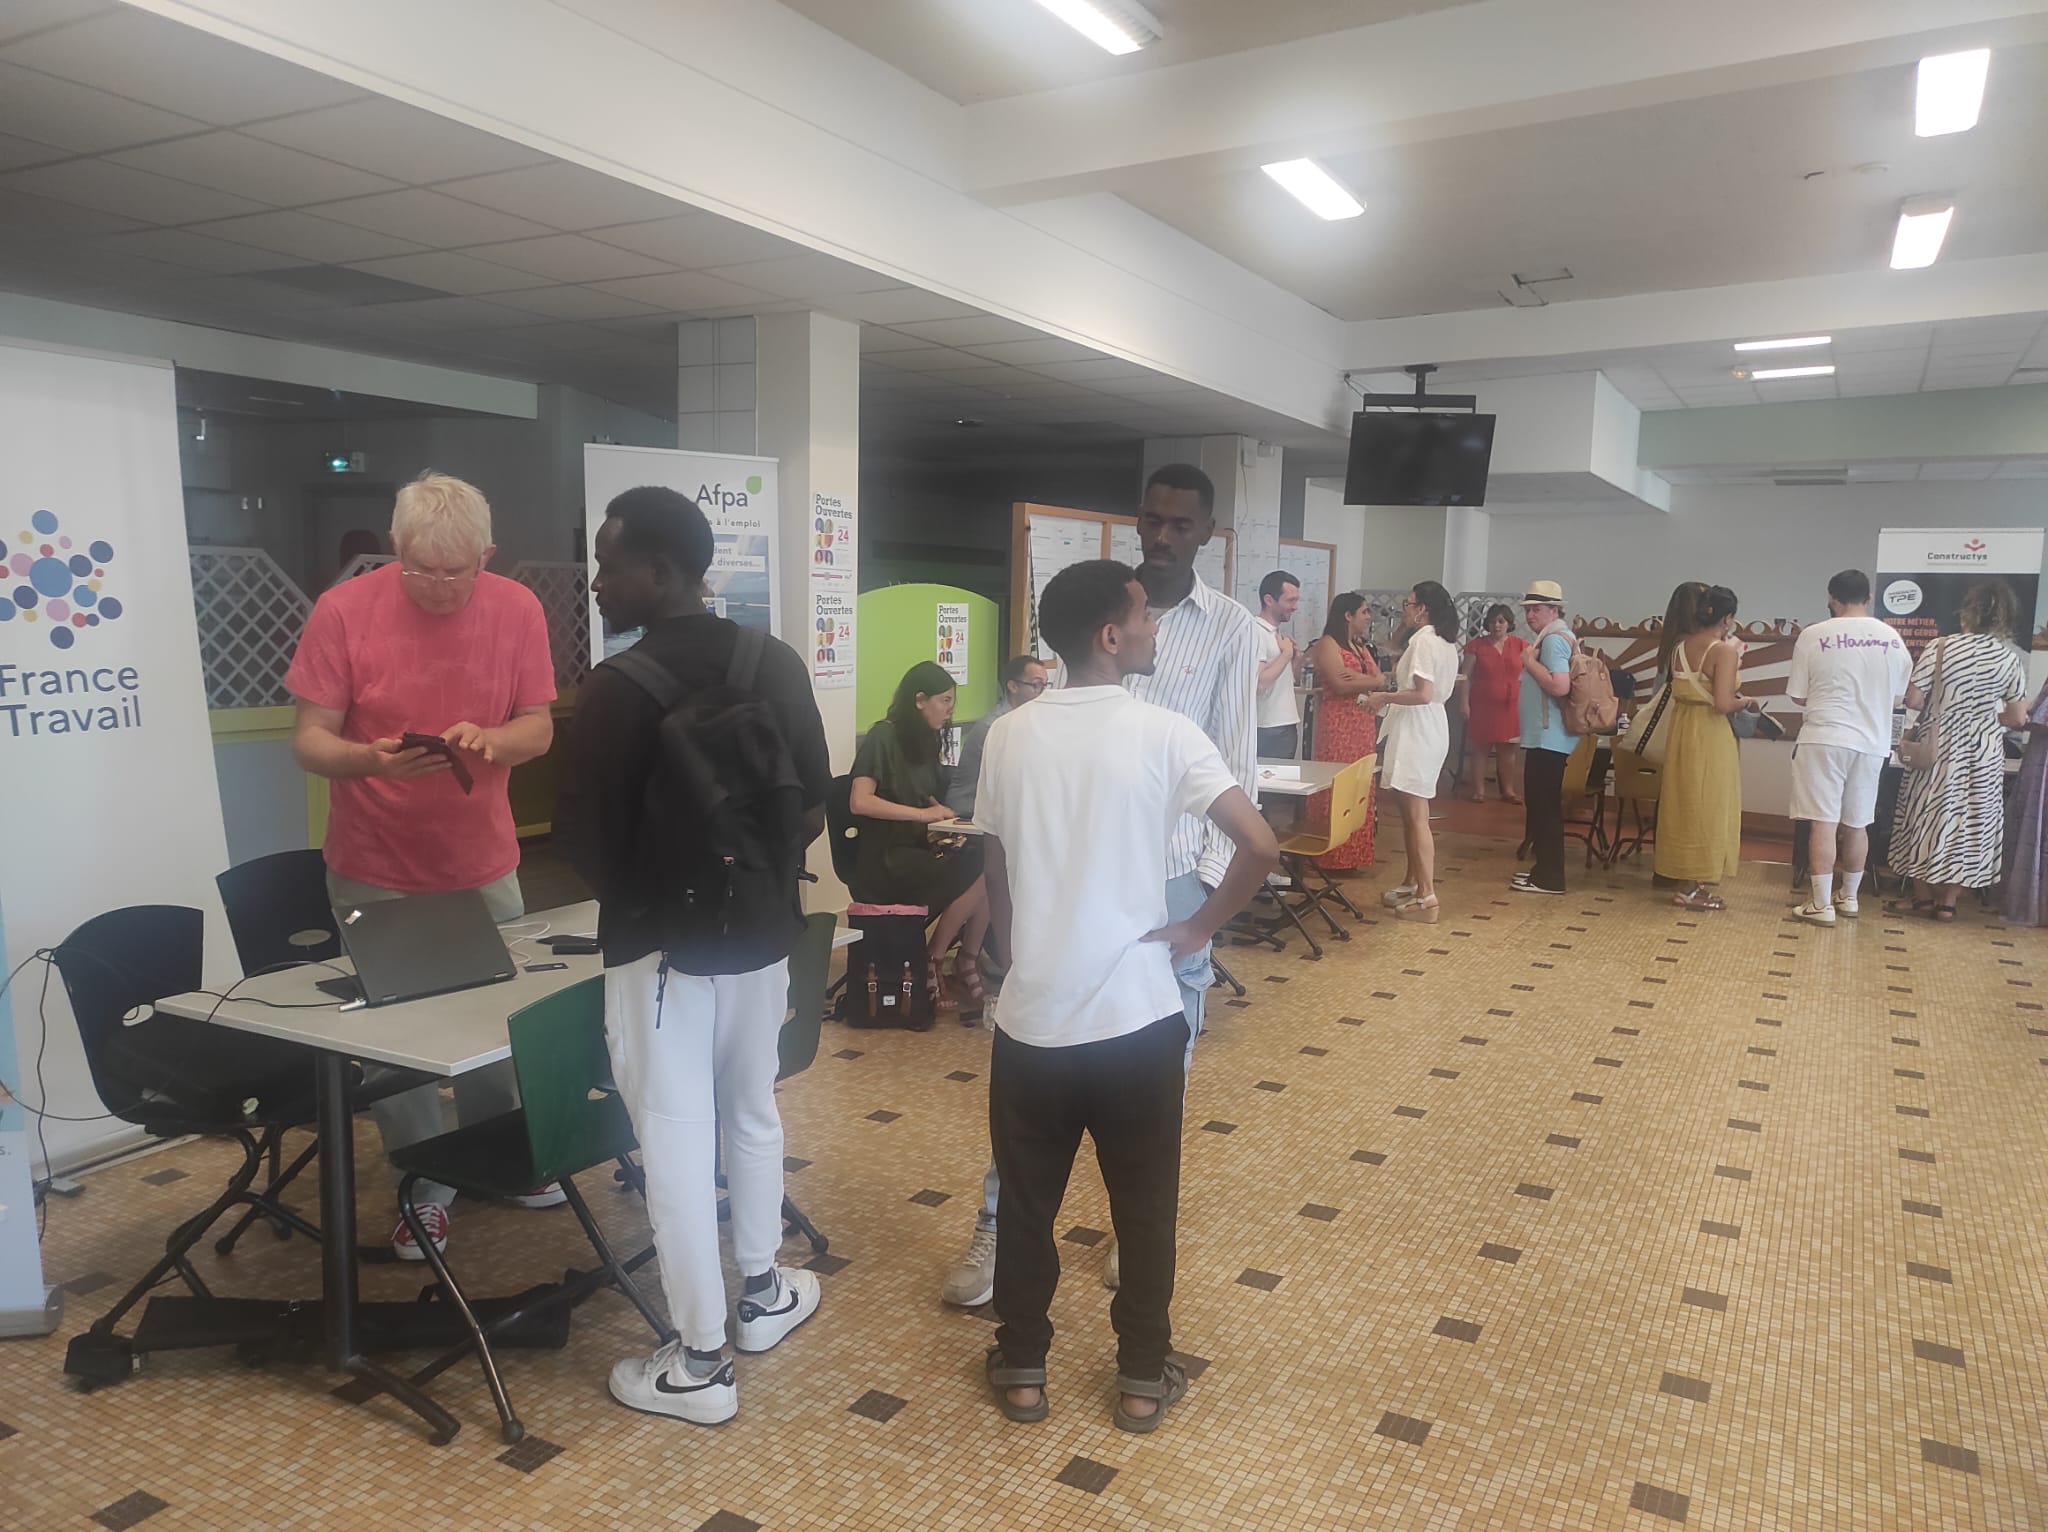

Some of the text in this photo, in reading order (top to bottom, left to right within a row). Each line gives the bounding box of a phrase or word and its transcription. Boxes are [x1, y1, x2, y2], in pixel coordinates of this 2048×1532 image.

[696, 483, 748, 513] Afpa
[815, 494, 842, 507] Portes
[815, 505, 853, 519] Ouvertes
[838, 528, 849, 542] 24
[1927, 552, 1988, 561] Constructys
[815, 594, 842, 605] Portes
[1889, 593, 1916, 603] TPE
[816, 604, 853, 615] Ouvertes
[938, 605, 959, 614] Portes
[838, 625, 850, 638] 24
[955, 631, 964, 643] 24
[0, 664, 139, 697] France
[0, 695, 142, 737] Travail
